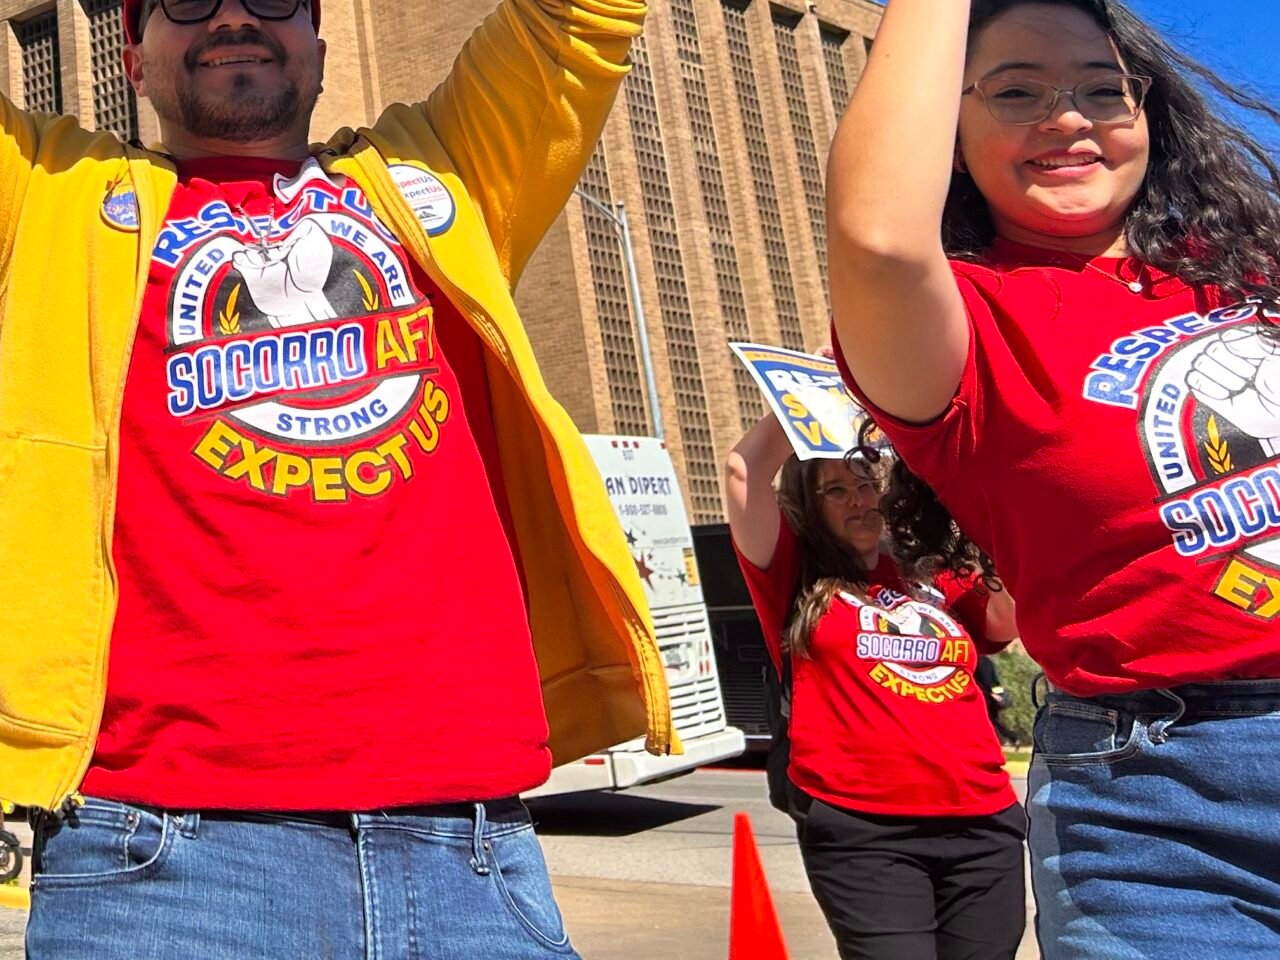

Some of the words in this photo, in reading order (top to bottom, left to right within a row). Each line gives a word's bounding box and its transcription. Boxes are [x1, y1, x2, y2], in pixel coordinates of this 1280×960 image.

[178, 247, 225, 337] UNITED
[330, 220, 368, 249] WE
[371, 251, 405, 301] ARE
[168, 326, 365, 417] SOCORRO
[375, 306, 437, 370] AFT
[192, 420, 414, 503] EXPECT
[407, 379, 451, 458] US
[276, 396, 389, 436] STRONG
[1156, 383, 1183, 480] UNITED
[606, 476, 626, 497] AN
[628, 476, 672, 496] DIPERT
[857, 634, 939, 663] SOCORRO
[940, 640, 969, 663] AFT
[869, 663, 954, 704] EXPECT
[948, 670, 971, 694] US
